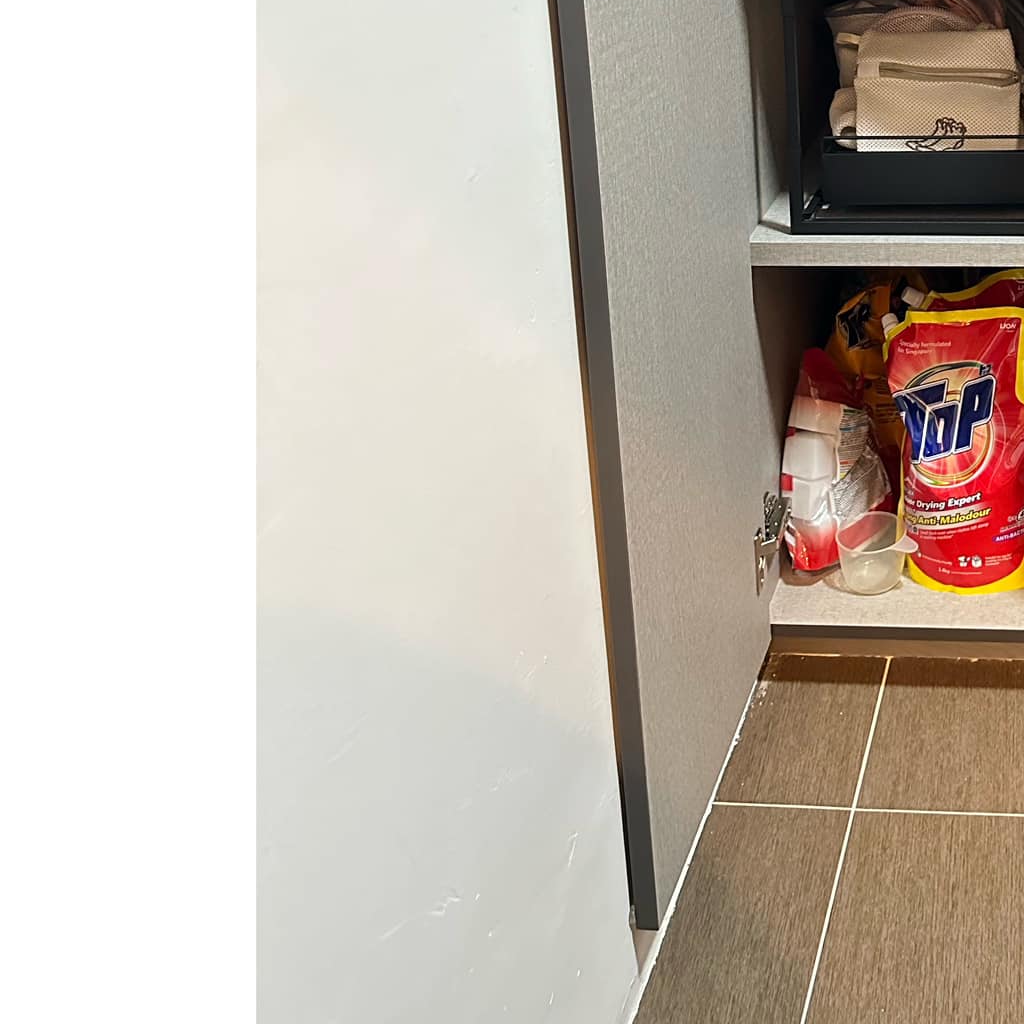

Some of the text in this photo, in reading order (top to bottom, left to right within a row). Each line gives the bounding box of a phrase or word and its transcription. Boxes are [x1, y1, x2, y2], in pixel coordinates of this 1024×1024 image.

[916, 498, 945, 511] Drying
[947, 492, 982, 508] Expert
[918, 507, 992, 526] Anti-Malodour
